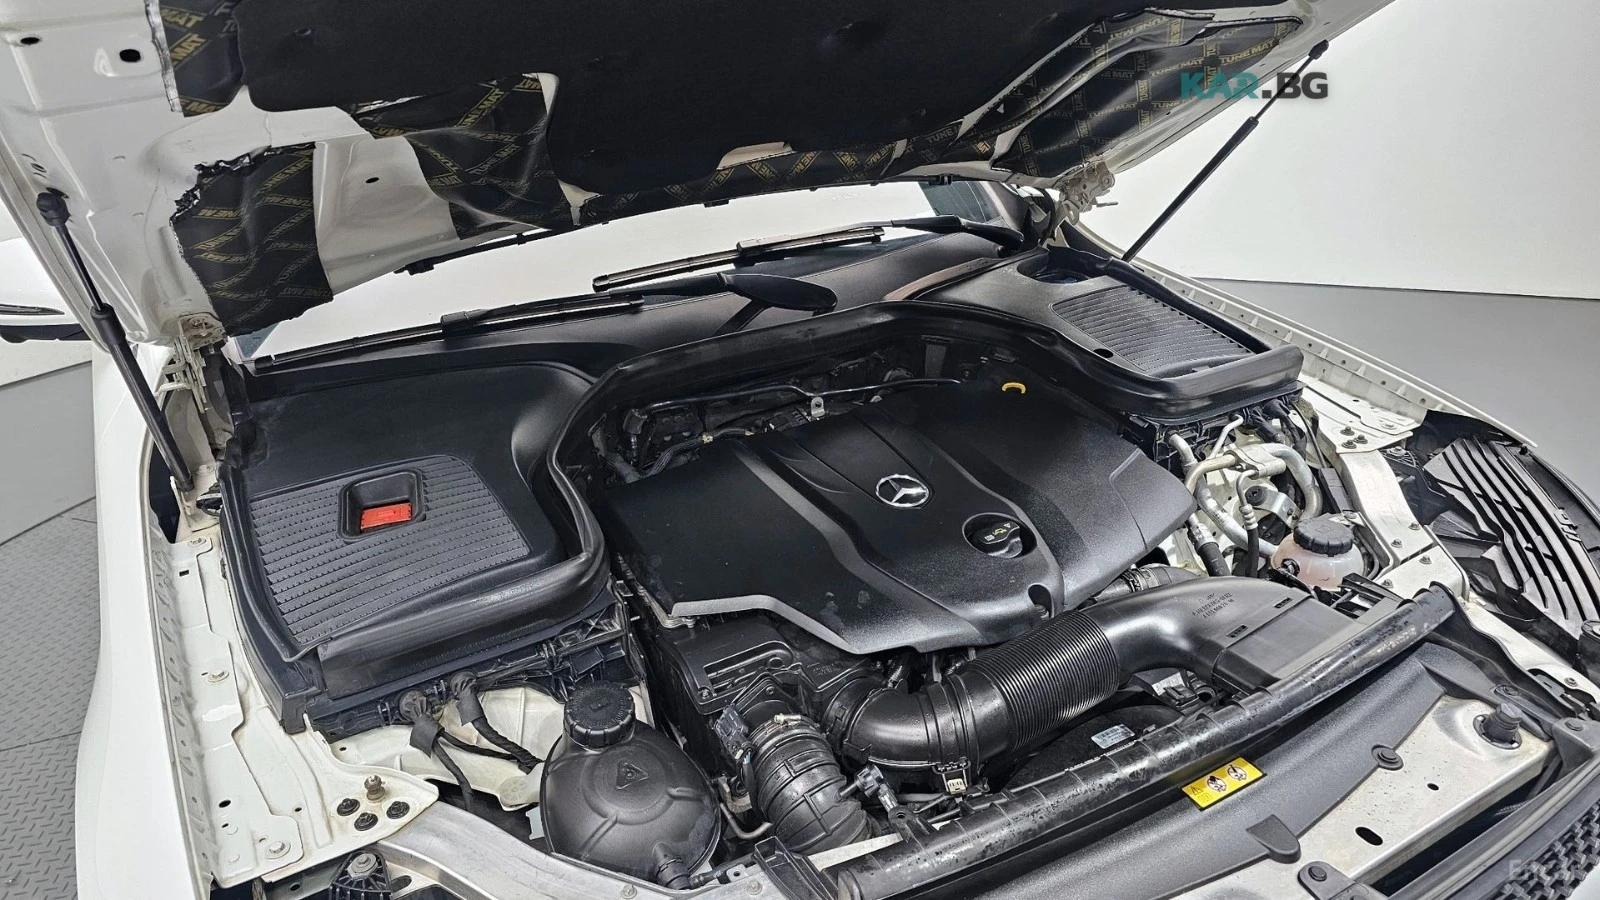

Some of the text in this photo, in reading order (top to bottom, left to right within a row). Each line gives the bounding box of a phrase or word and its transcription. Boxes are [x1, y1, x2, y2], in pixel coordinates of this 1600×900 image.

[1220, 41, 1275, 63] TUNE MAT
[1180, 58, 1204, 69] MAT
[1112, 71, 1135, 79] MAT
[925, 128, 955, 144] TUNE
